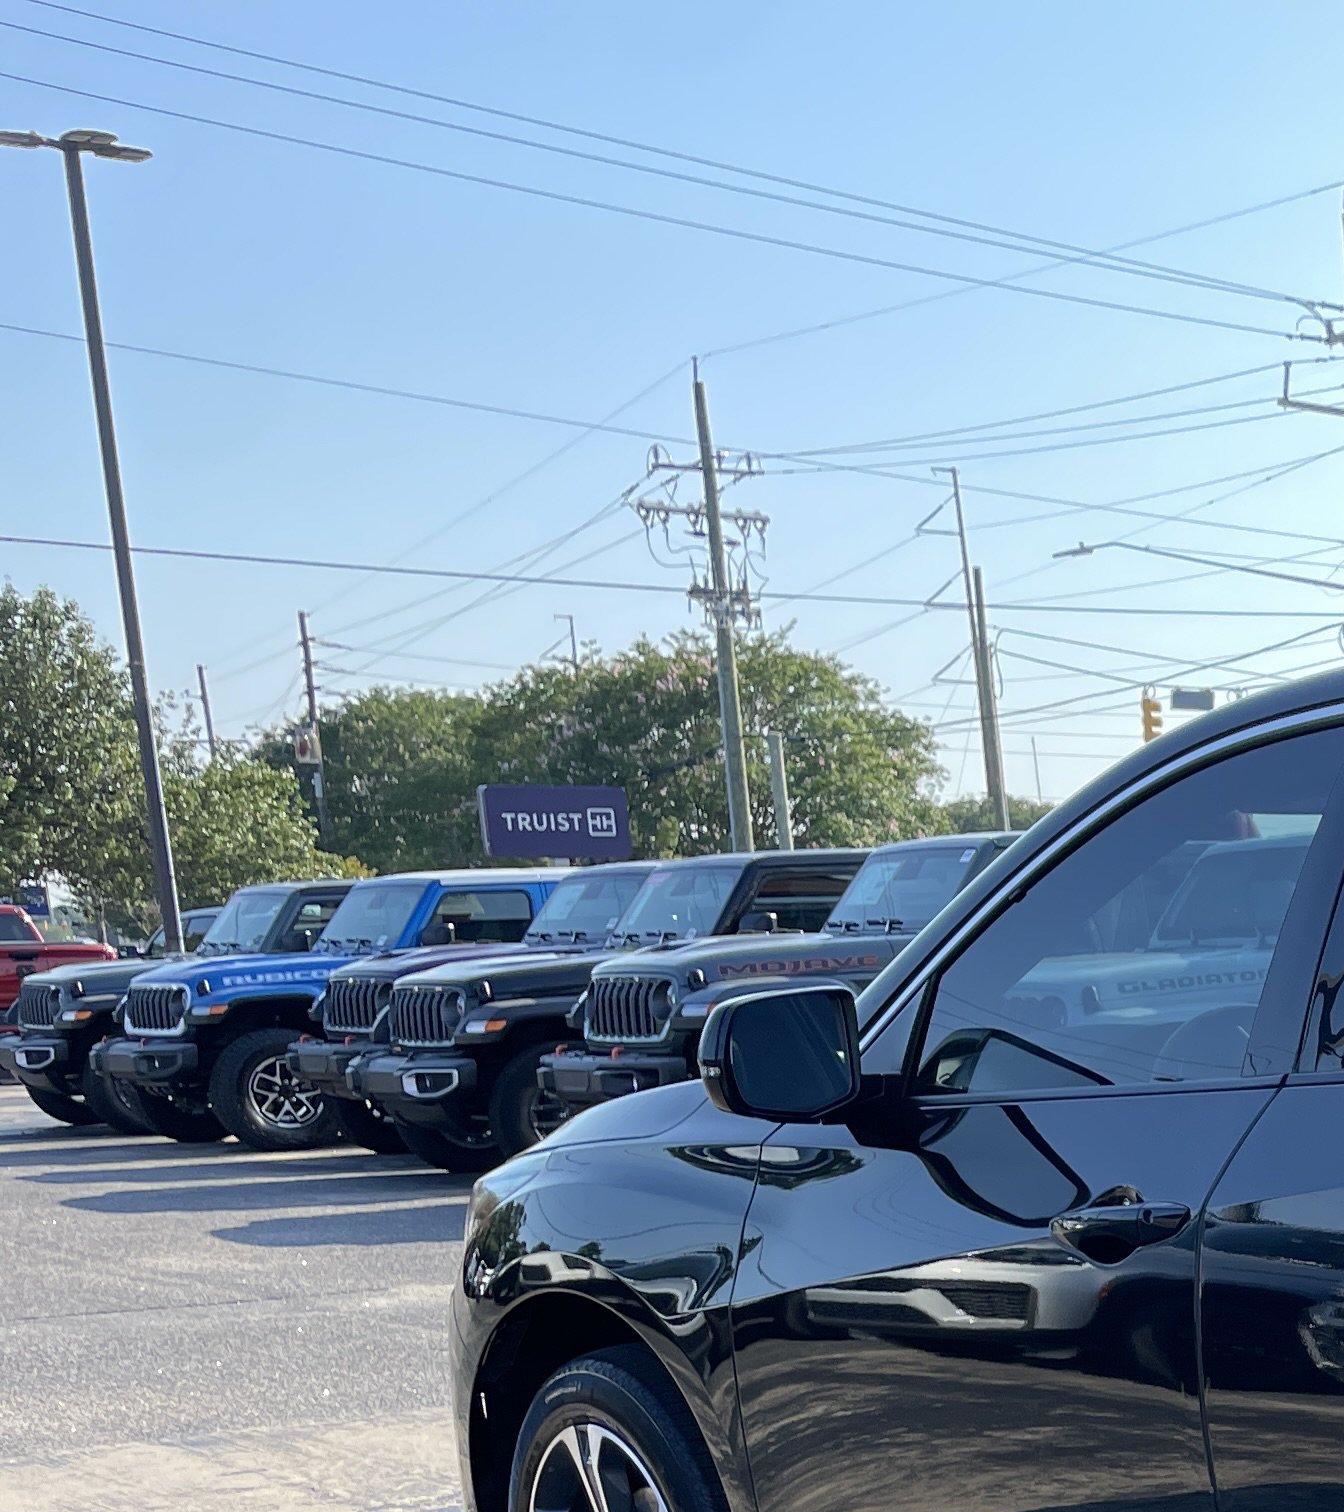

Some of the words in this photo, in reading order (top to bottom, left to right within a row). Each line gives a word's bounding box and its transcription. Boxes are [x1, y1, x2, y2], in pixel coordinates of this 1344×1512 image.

[501, 811, 583, 833] TRUIST
[719, 955, 880, 976] MOJAVE
[222, 969, 330, 987] RUBICO
